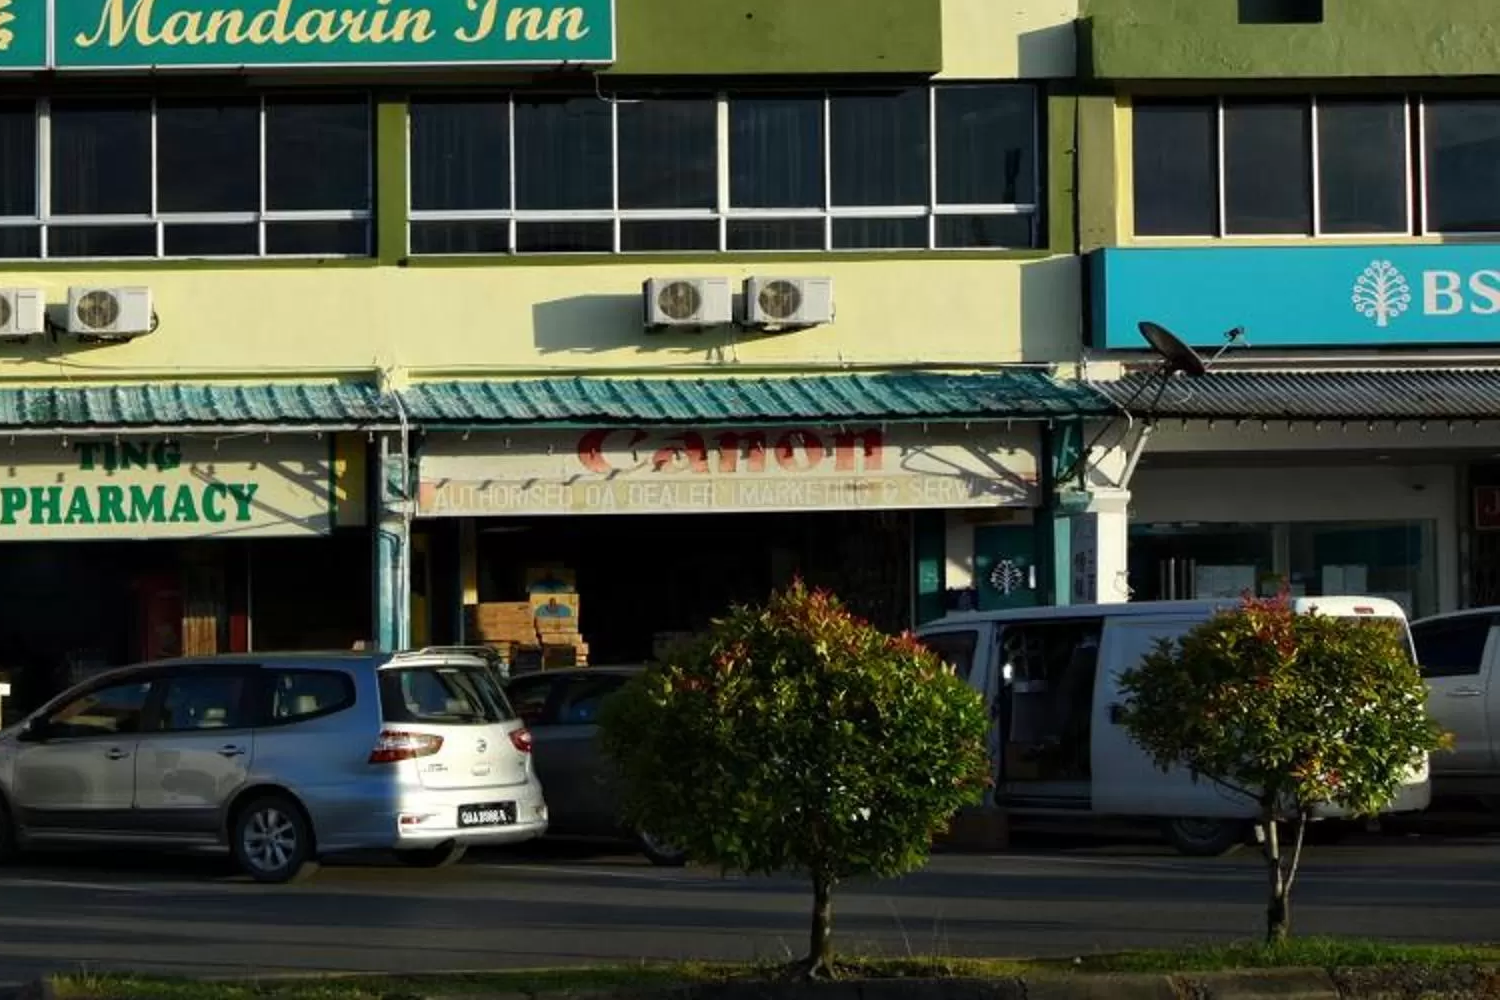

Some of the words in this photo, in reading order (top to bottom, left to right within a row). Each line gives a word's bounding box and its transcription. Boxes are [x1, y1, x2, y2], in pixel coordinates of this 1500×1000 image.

[73, 440, 182, 472] TING
[576, 427, 885, 473] Canon
[0, 483, 259, 525] PHARMACY
[433, 482, 573, 510] AUTHORISED
[629, 481, 717, 507] DEALER
[738, 479, 867, 505] MARKETING
